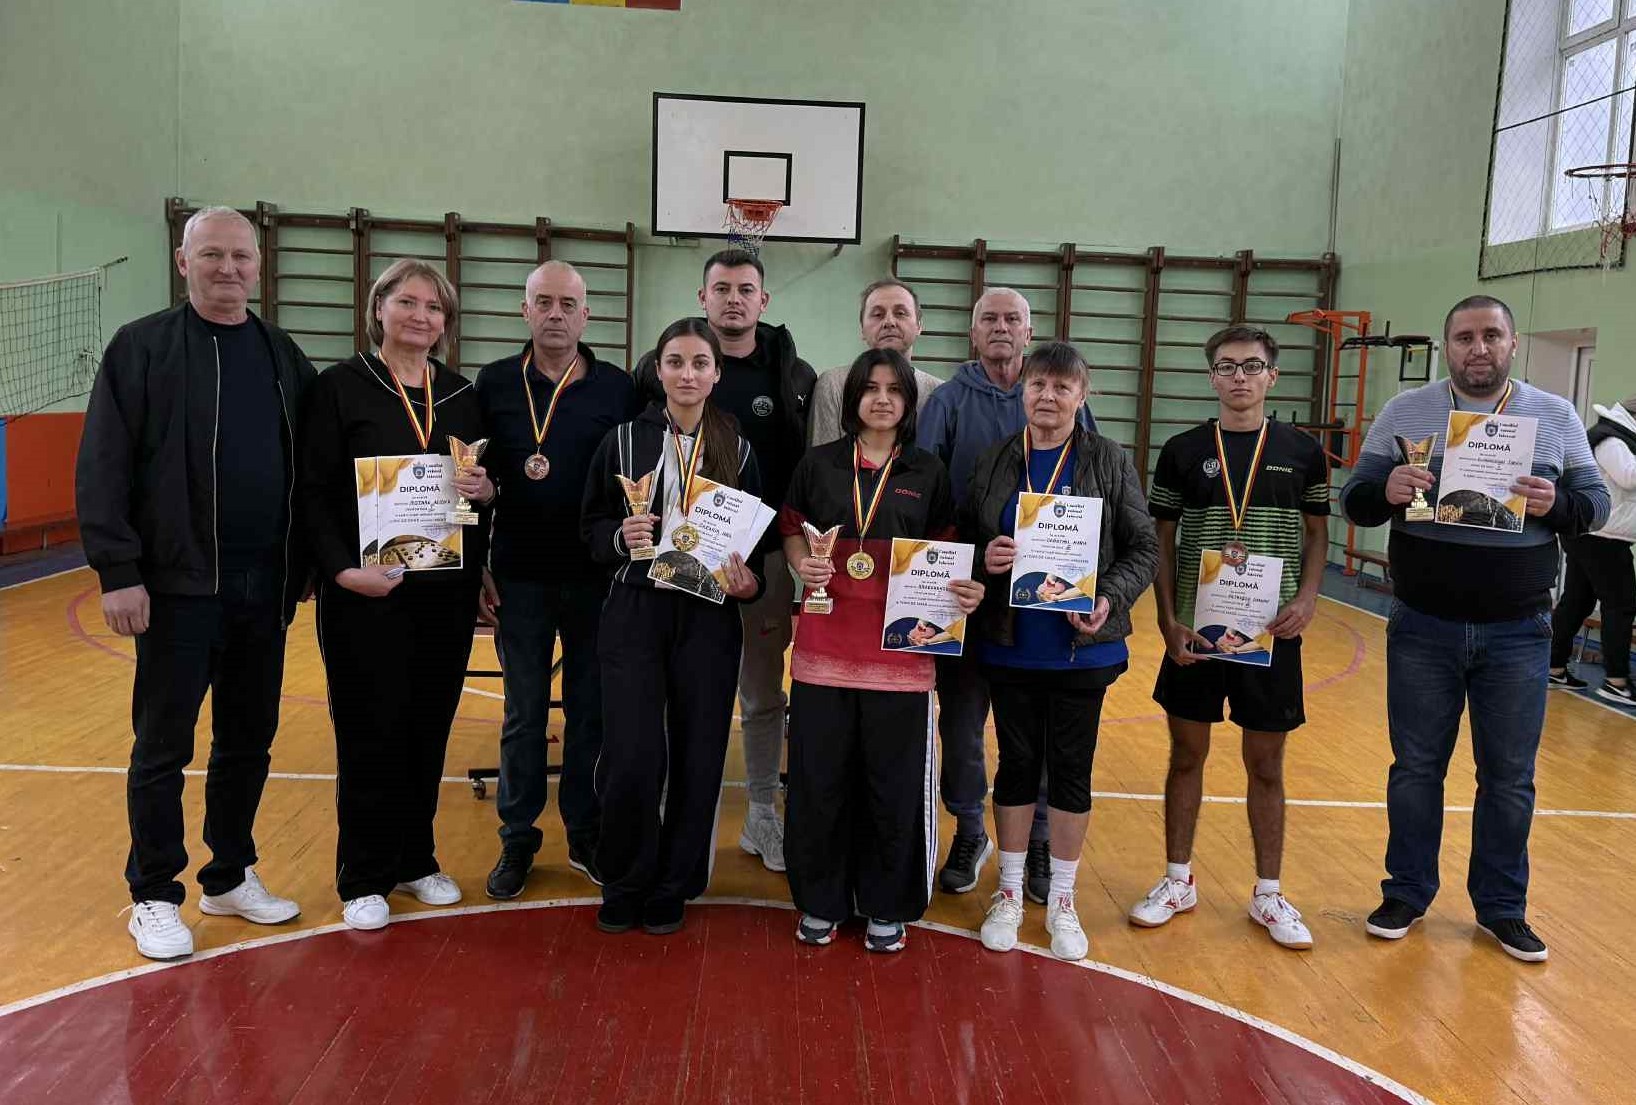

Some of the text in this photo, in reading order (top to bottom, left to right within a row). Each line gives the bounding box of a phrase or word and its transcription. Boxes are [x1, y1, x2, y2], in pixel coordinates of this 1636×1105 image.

[1265, 465, 1294, 473] DONIC
[399, 484, 441, 493] DIPLOMĂ
[895, 488, 922, 499] DONIC
